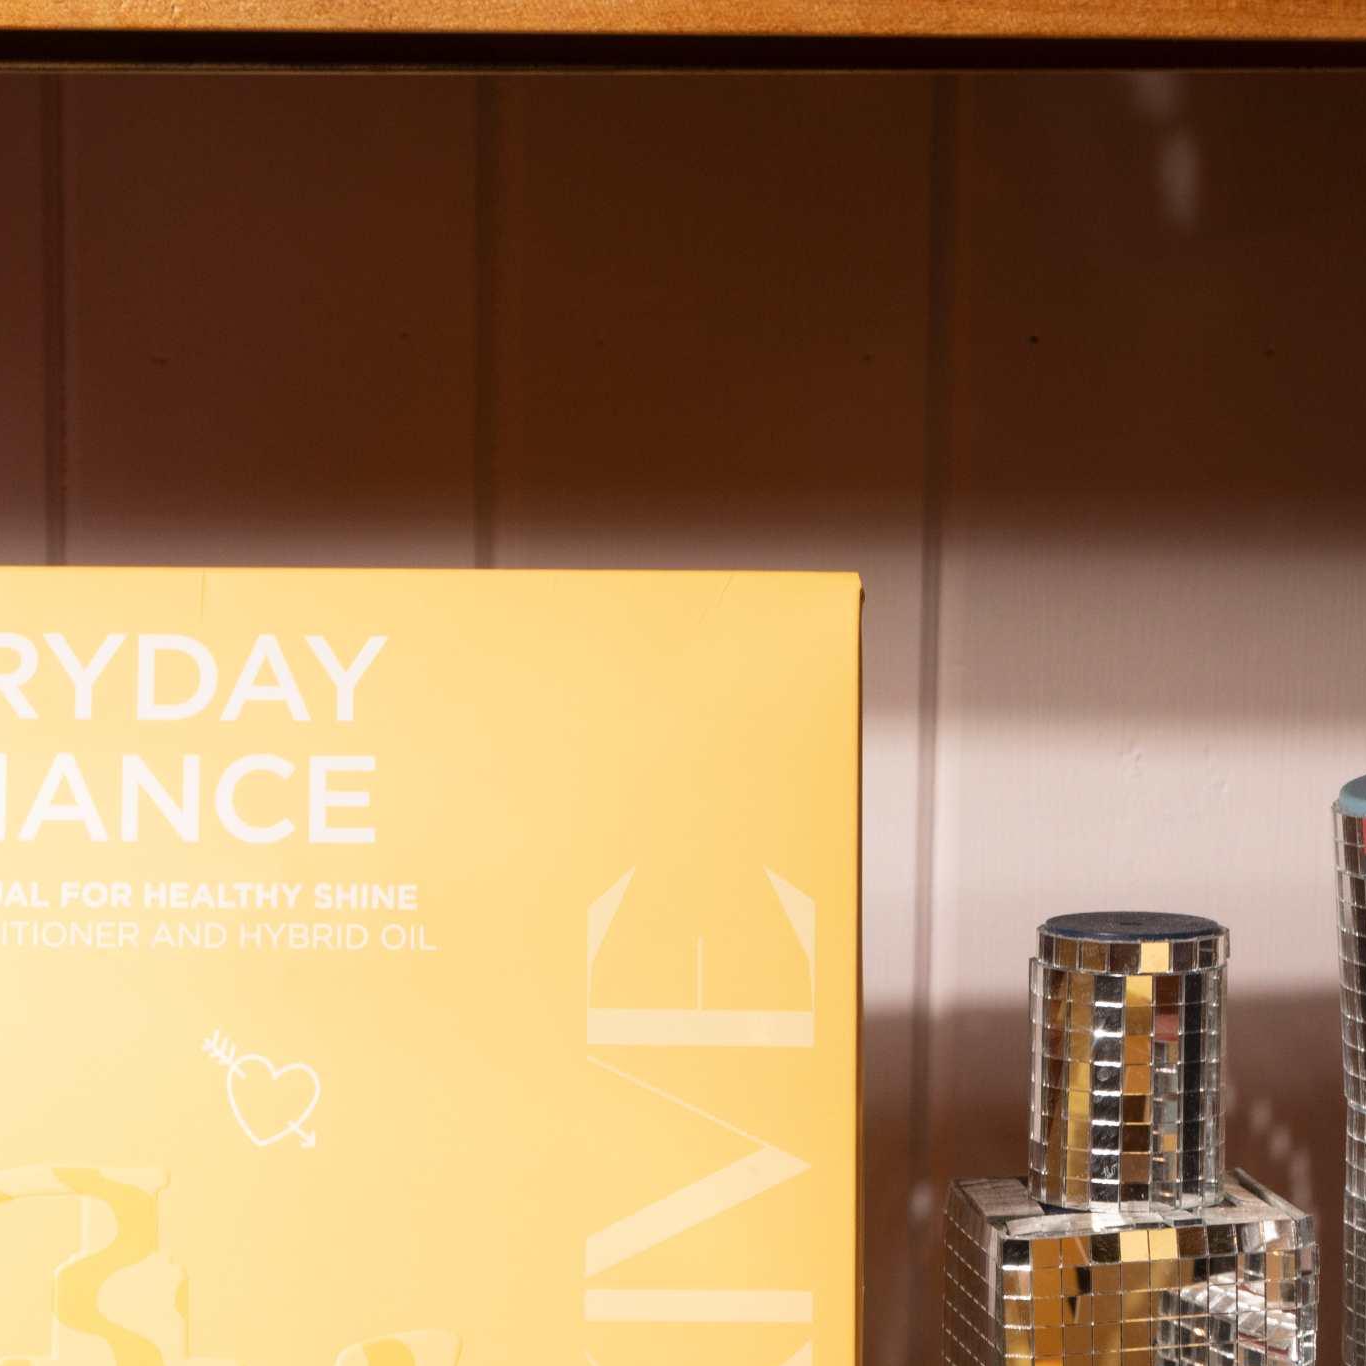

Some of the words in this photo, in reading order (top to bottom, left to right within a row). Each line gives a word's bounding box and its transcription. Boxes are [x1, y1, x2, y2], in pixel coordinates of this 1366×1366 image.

[61, 881, 132, 908] FOR
[144, 881, 303, 909] HEALTHY
[313, 883, 418, 910] SHINE
[151, 921, 227, 948] AND
[240, 922, 369, 949] HYBRID
[381, 923, 437, 950] OIL
